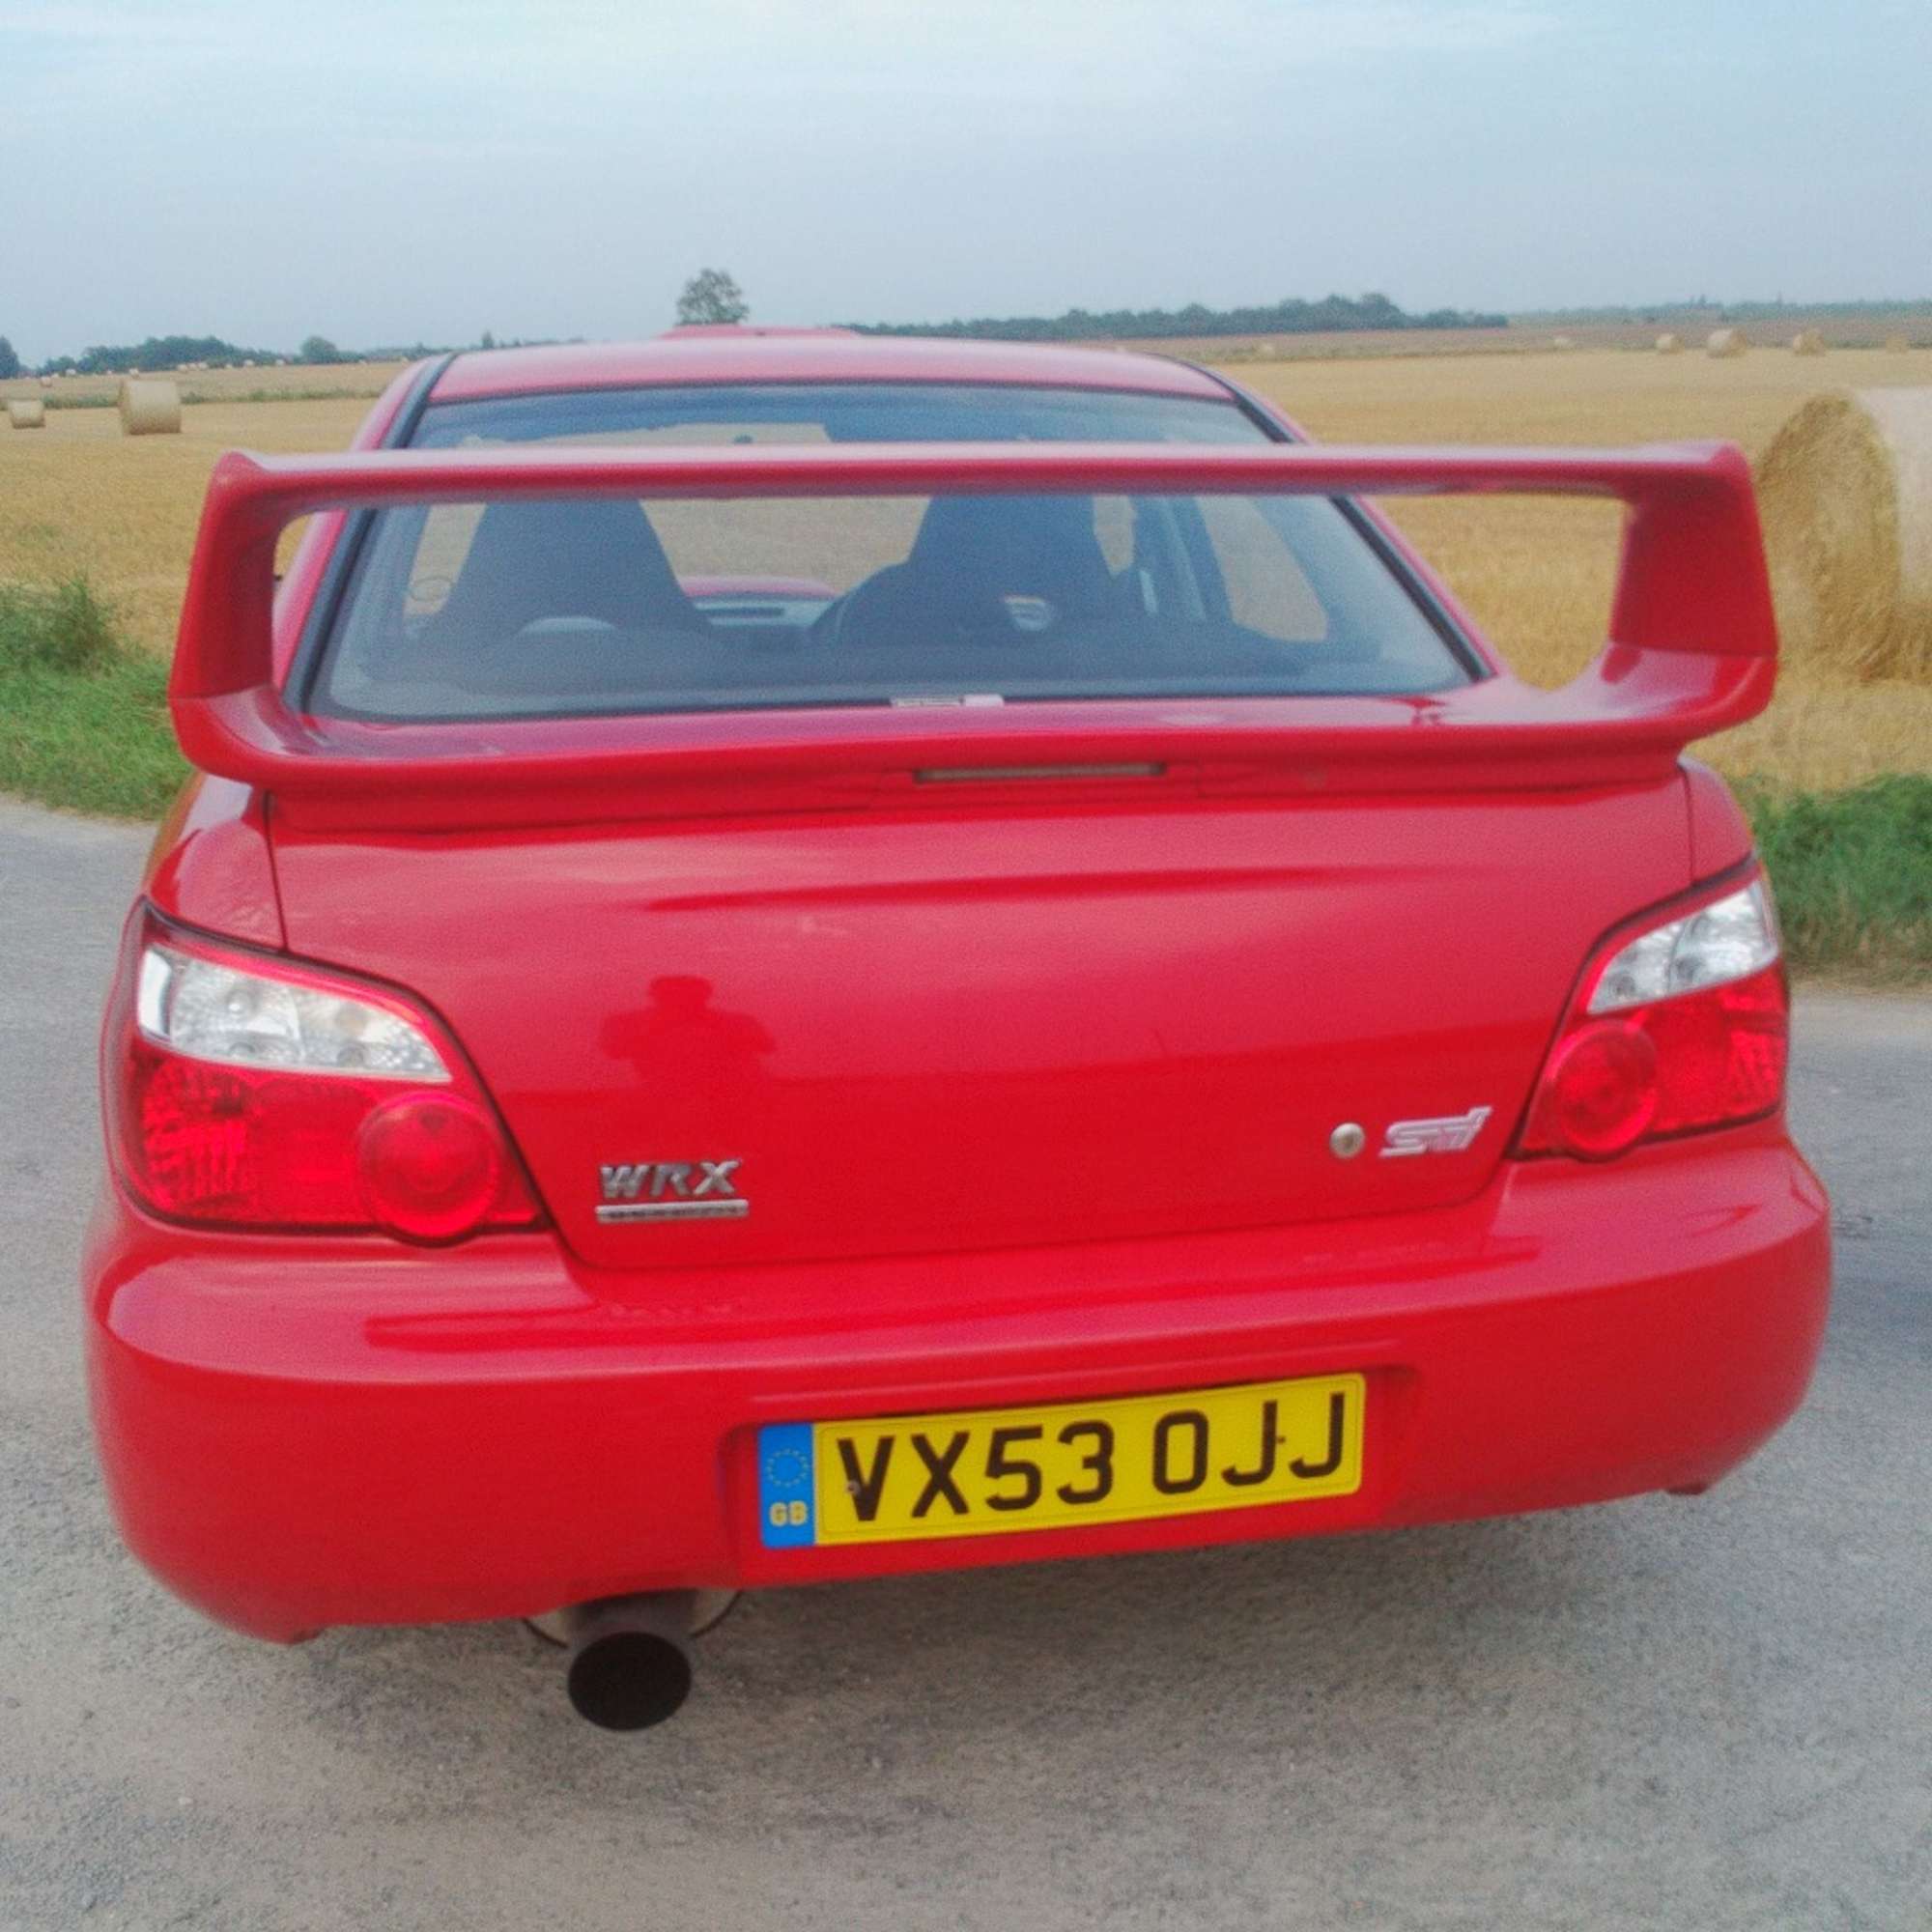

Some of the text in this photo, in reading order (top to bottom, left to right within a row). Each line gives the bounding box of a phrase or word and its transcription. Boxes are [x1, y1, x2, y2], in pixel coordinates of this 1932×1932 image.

[600, 1160, 741, 1198] WRX
[837, 1391, 1346, 1523] VX53 OJJ
[769, 1500, 809, 1527] GB
